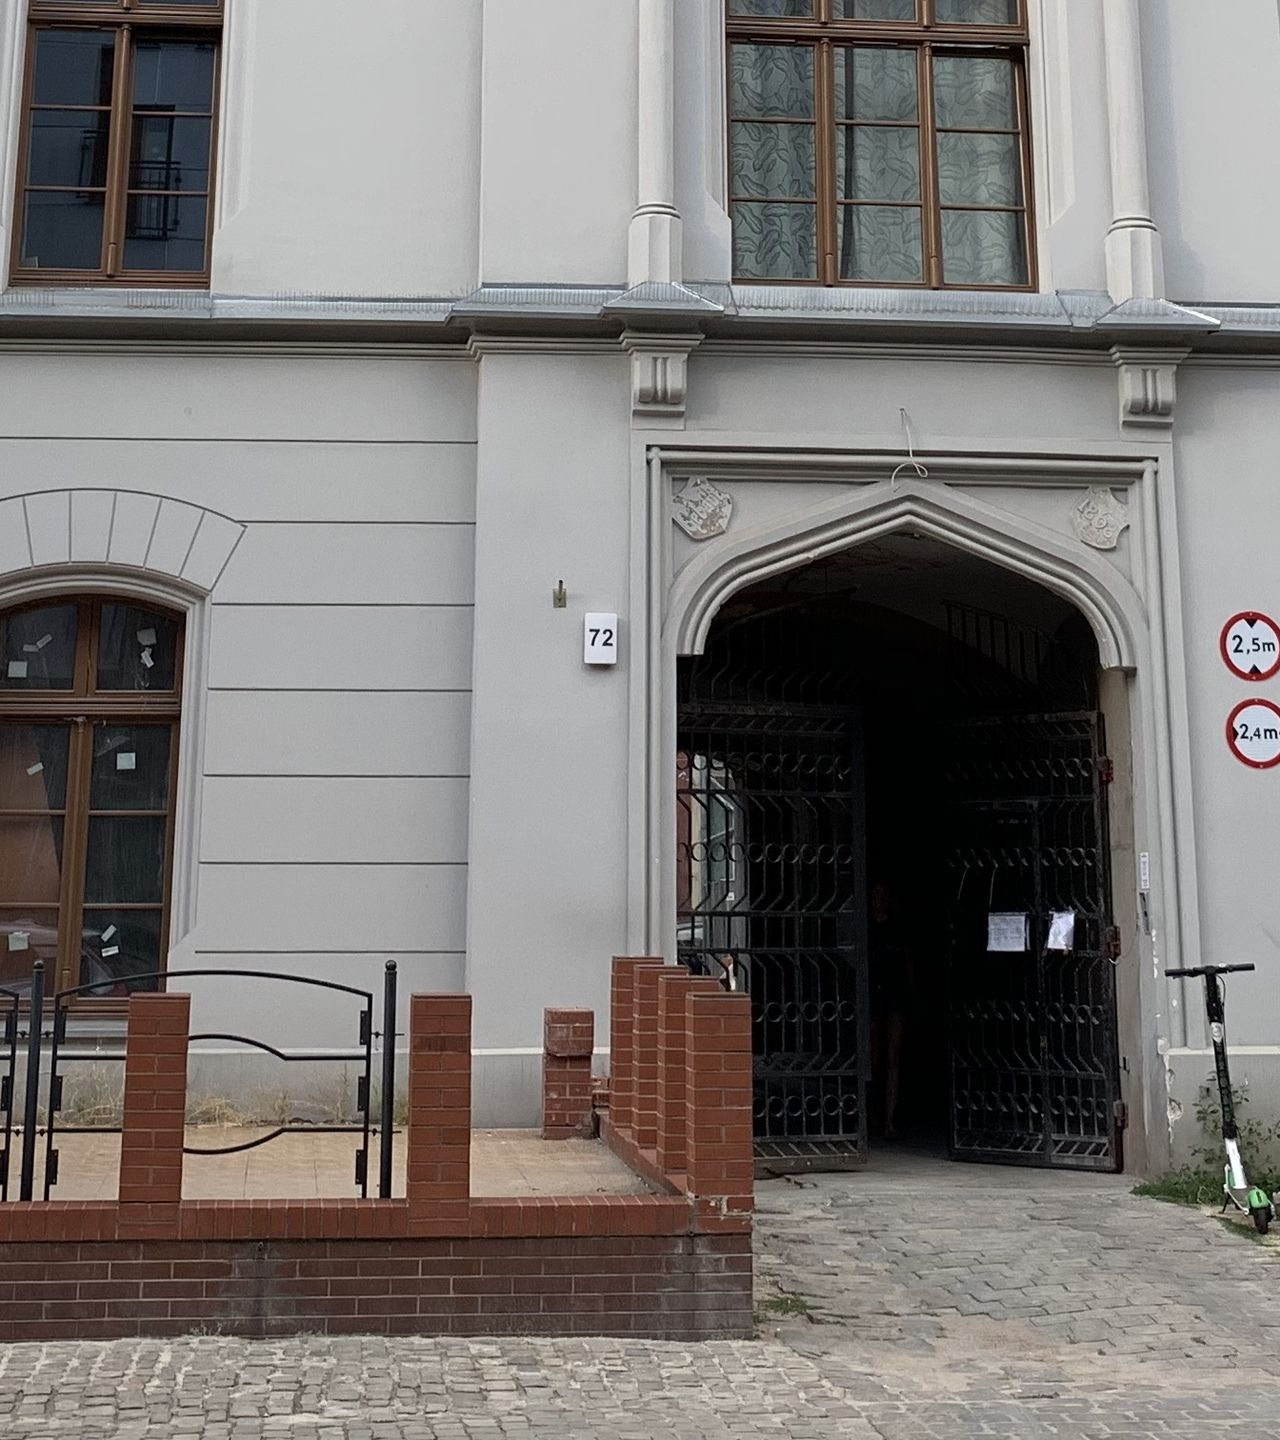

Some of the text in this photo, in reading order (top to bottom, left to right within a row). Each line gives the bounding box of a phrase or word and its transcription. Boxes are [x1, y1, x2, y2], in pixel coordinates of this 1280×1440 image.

[589, 629, 613, 646] 72
[1232, 634, 1276, 655] 2,5m
[1239, 723, 1278, 741] 2,4m
